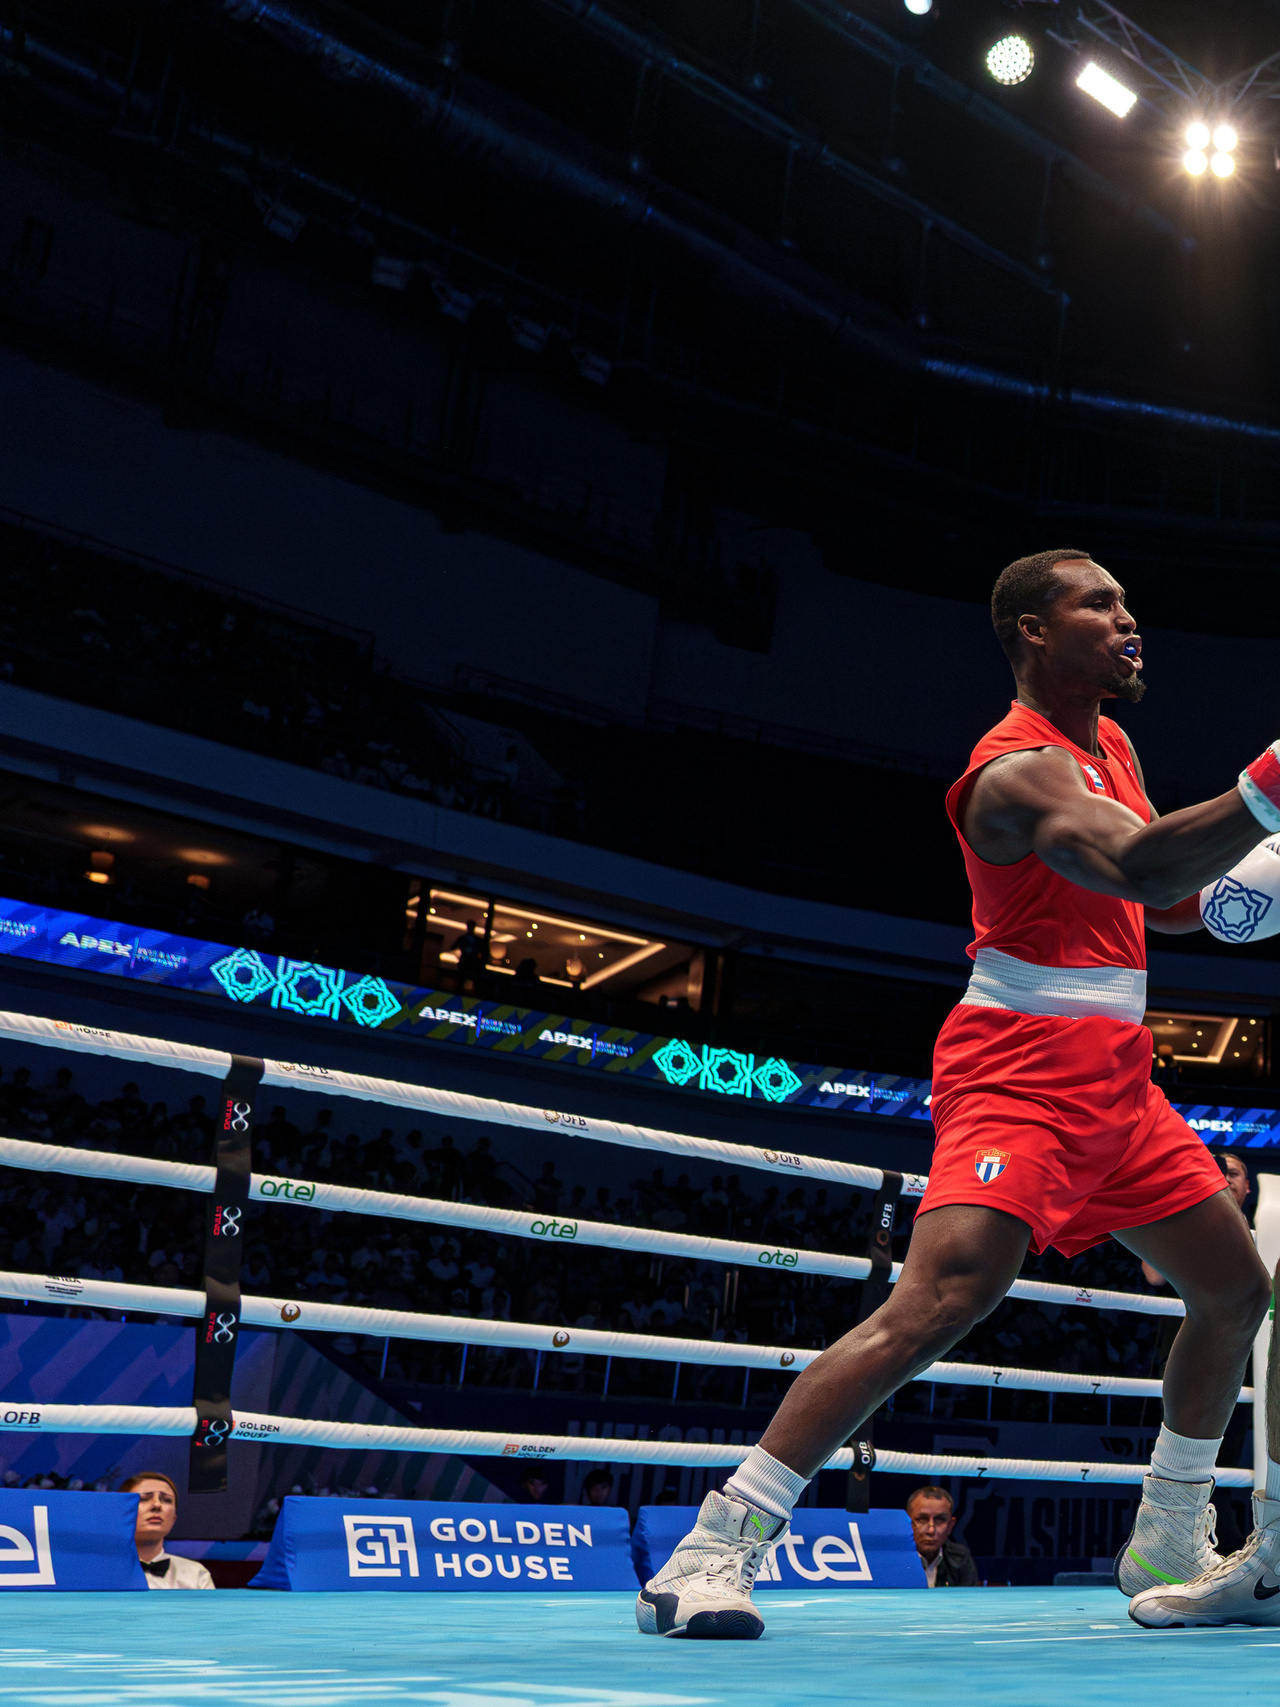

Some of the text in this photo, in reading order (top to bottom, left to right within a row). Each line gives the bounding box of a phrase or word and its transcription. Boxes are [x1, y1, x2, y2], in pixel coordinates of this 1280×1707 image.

[59, 931, 133, 958] APEX
[418, 1005, 478, 1028] APEX
[538, 1029, 594, 1050] APEX
[818, 1081, 870, 1098] APEX
[224, 1100, 233, 1130] STING
[1187, 1118, 1234, 1132] APEX
[260, 1179, 316, 1202] artel
[213, 1206, 223, 1236] STING
[881, 1203, 893, 1229] OFB
[530, 1219, 578, 1240] artel
[758, 1249, 799, 1267] artel
[206, 1312, 216, 1343] STING
[3, 1411, 41, 1425] OFB
[239, 1421, 280, 1435] GOLDEN
[521, 1445, 556, 1454] GOLDEN
[430, 1516, 593, 1548] GOLDEN
[755, 1522, 873, 1582] rtel
[435, 1553, 573, 1583] HOUSE
